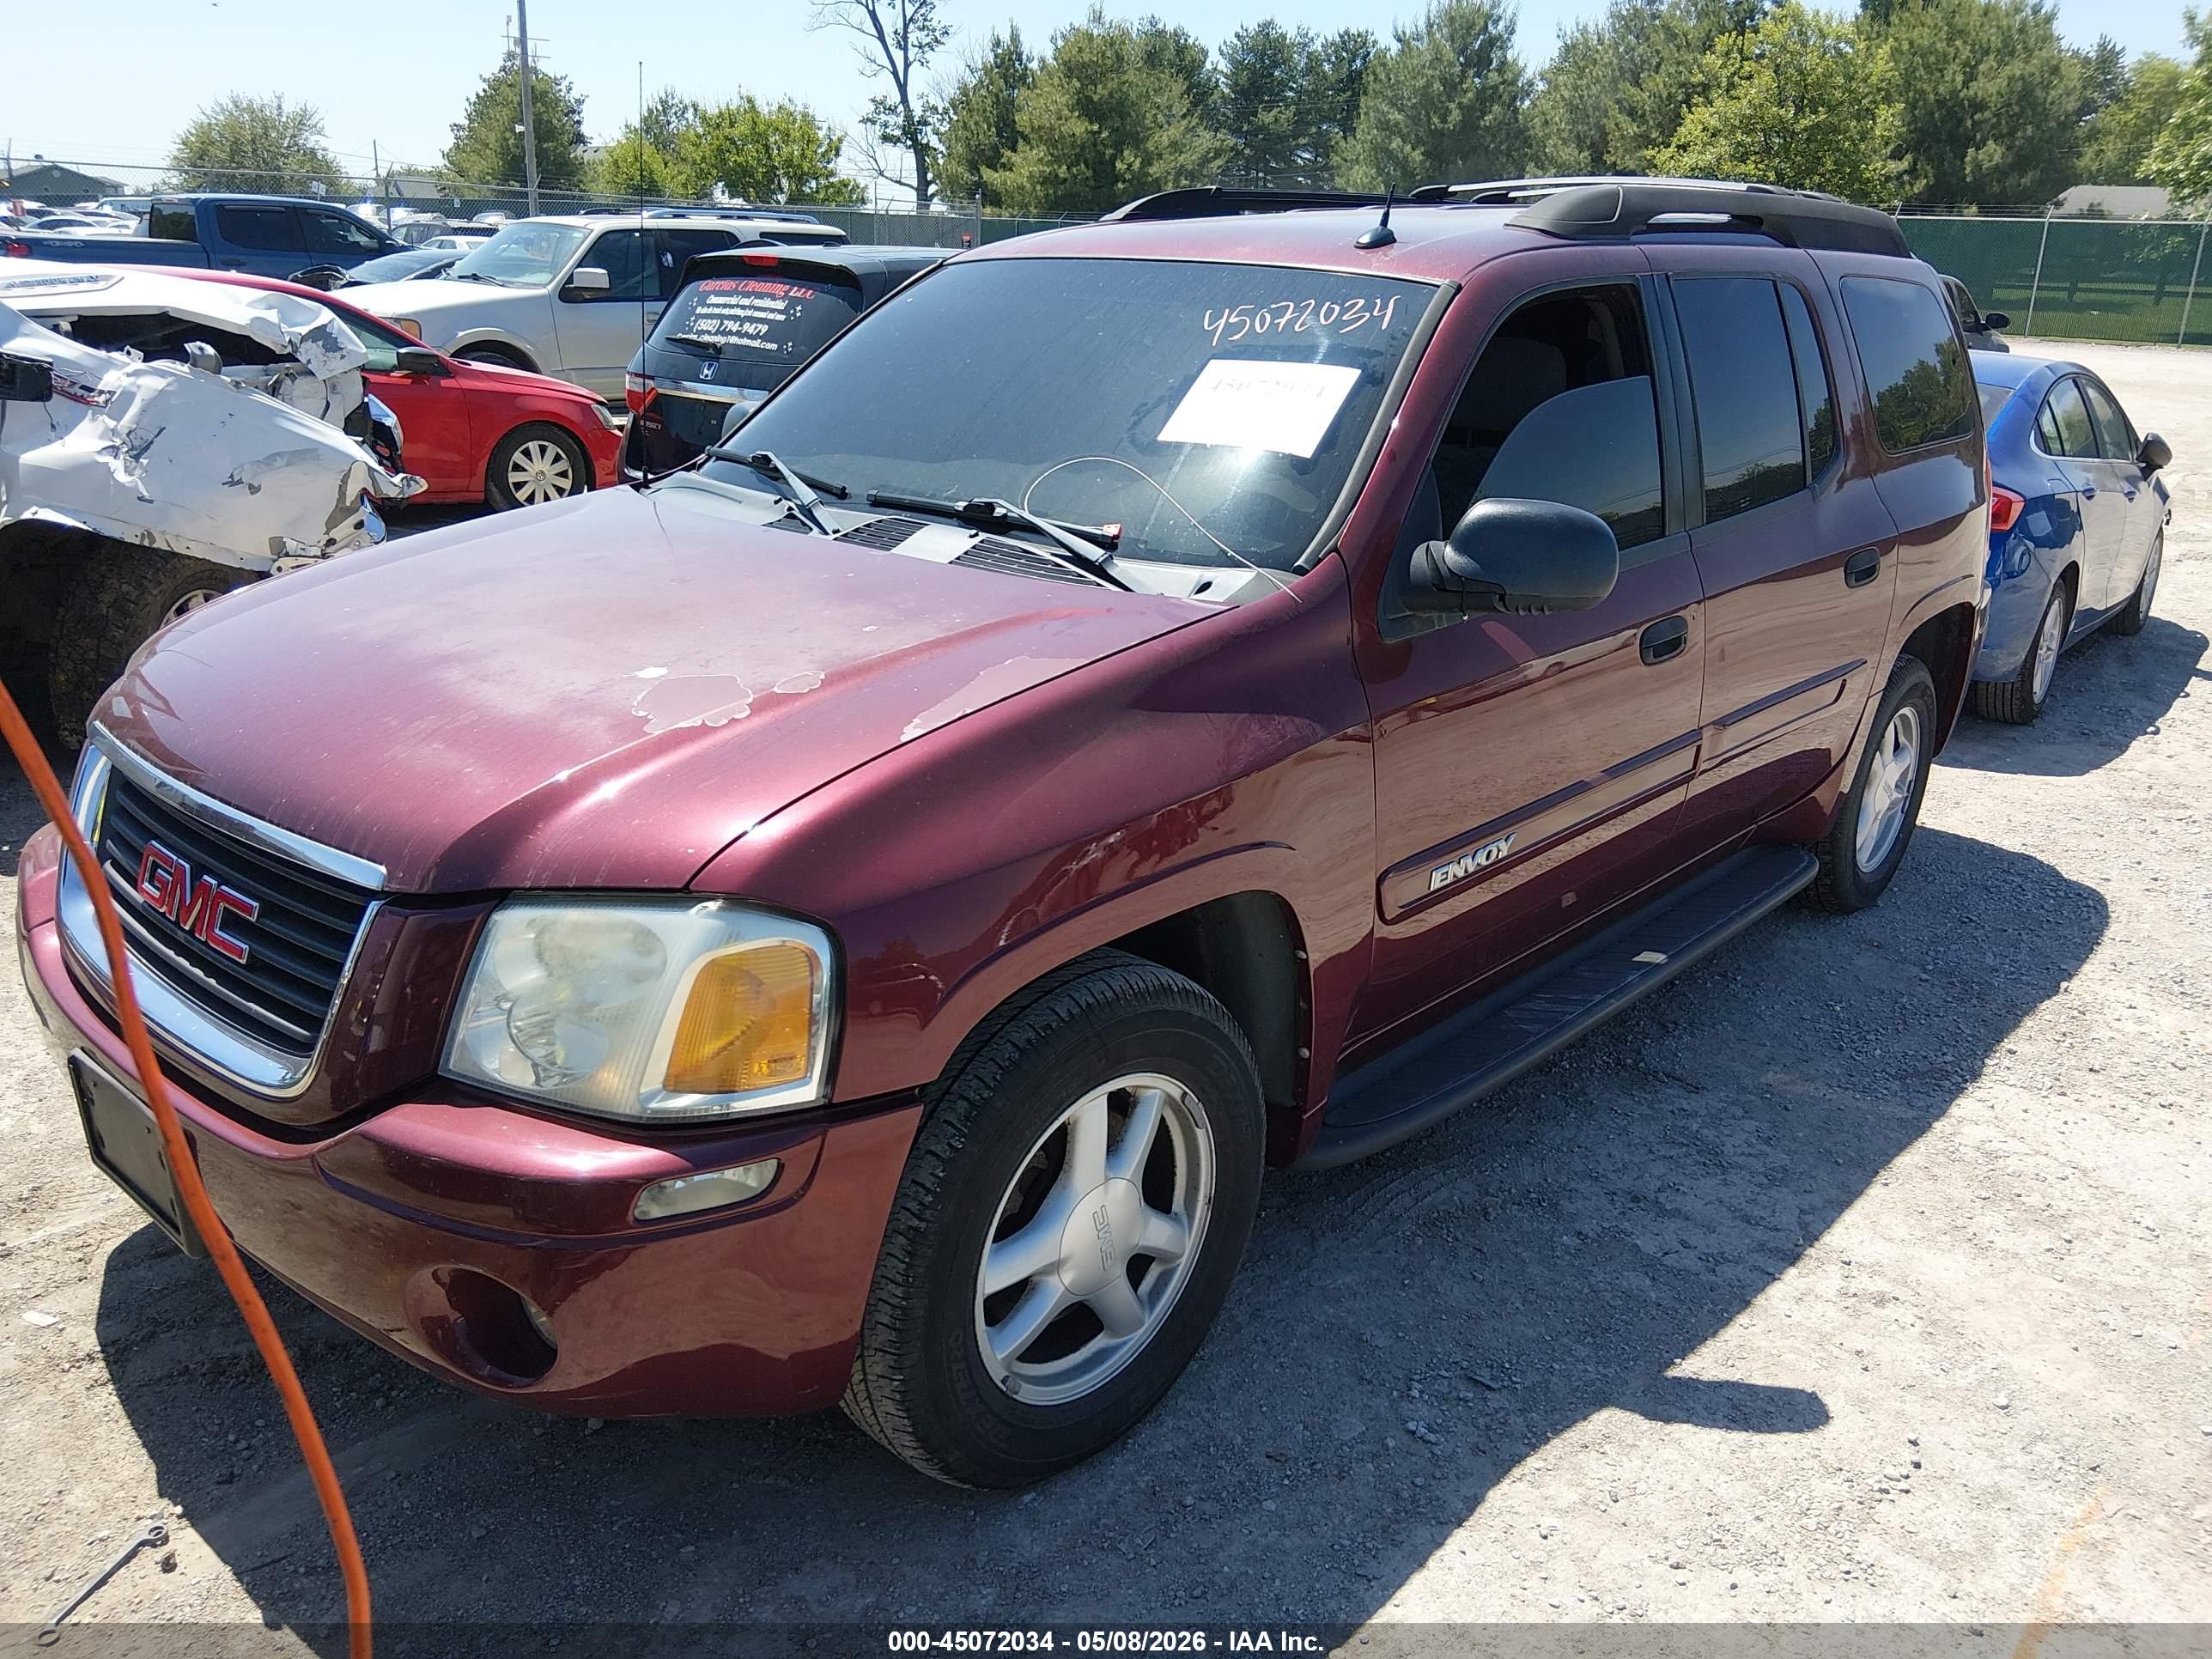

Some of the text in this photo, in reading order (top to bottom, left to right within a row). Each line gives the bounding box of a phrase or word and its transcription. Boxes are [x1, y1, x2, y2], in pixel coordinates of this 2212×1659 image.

[738, 280, 789, 297] Cleaning
[788, 287, 817, 300] LLC
[693, 319, 769, 336] (502) 794-9479
[1203, 295, 1401, 346] 45072034
[1429, 832, 1516, 890] ENVOY
[137, 840, 259, 964] GMC
[1092, 1204, 1116, 1271] GMC
